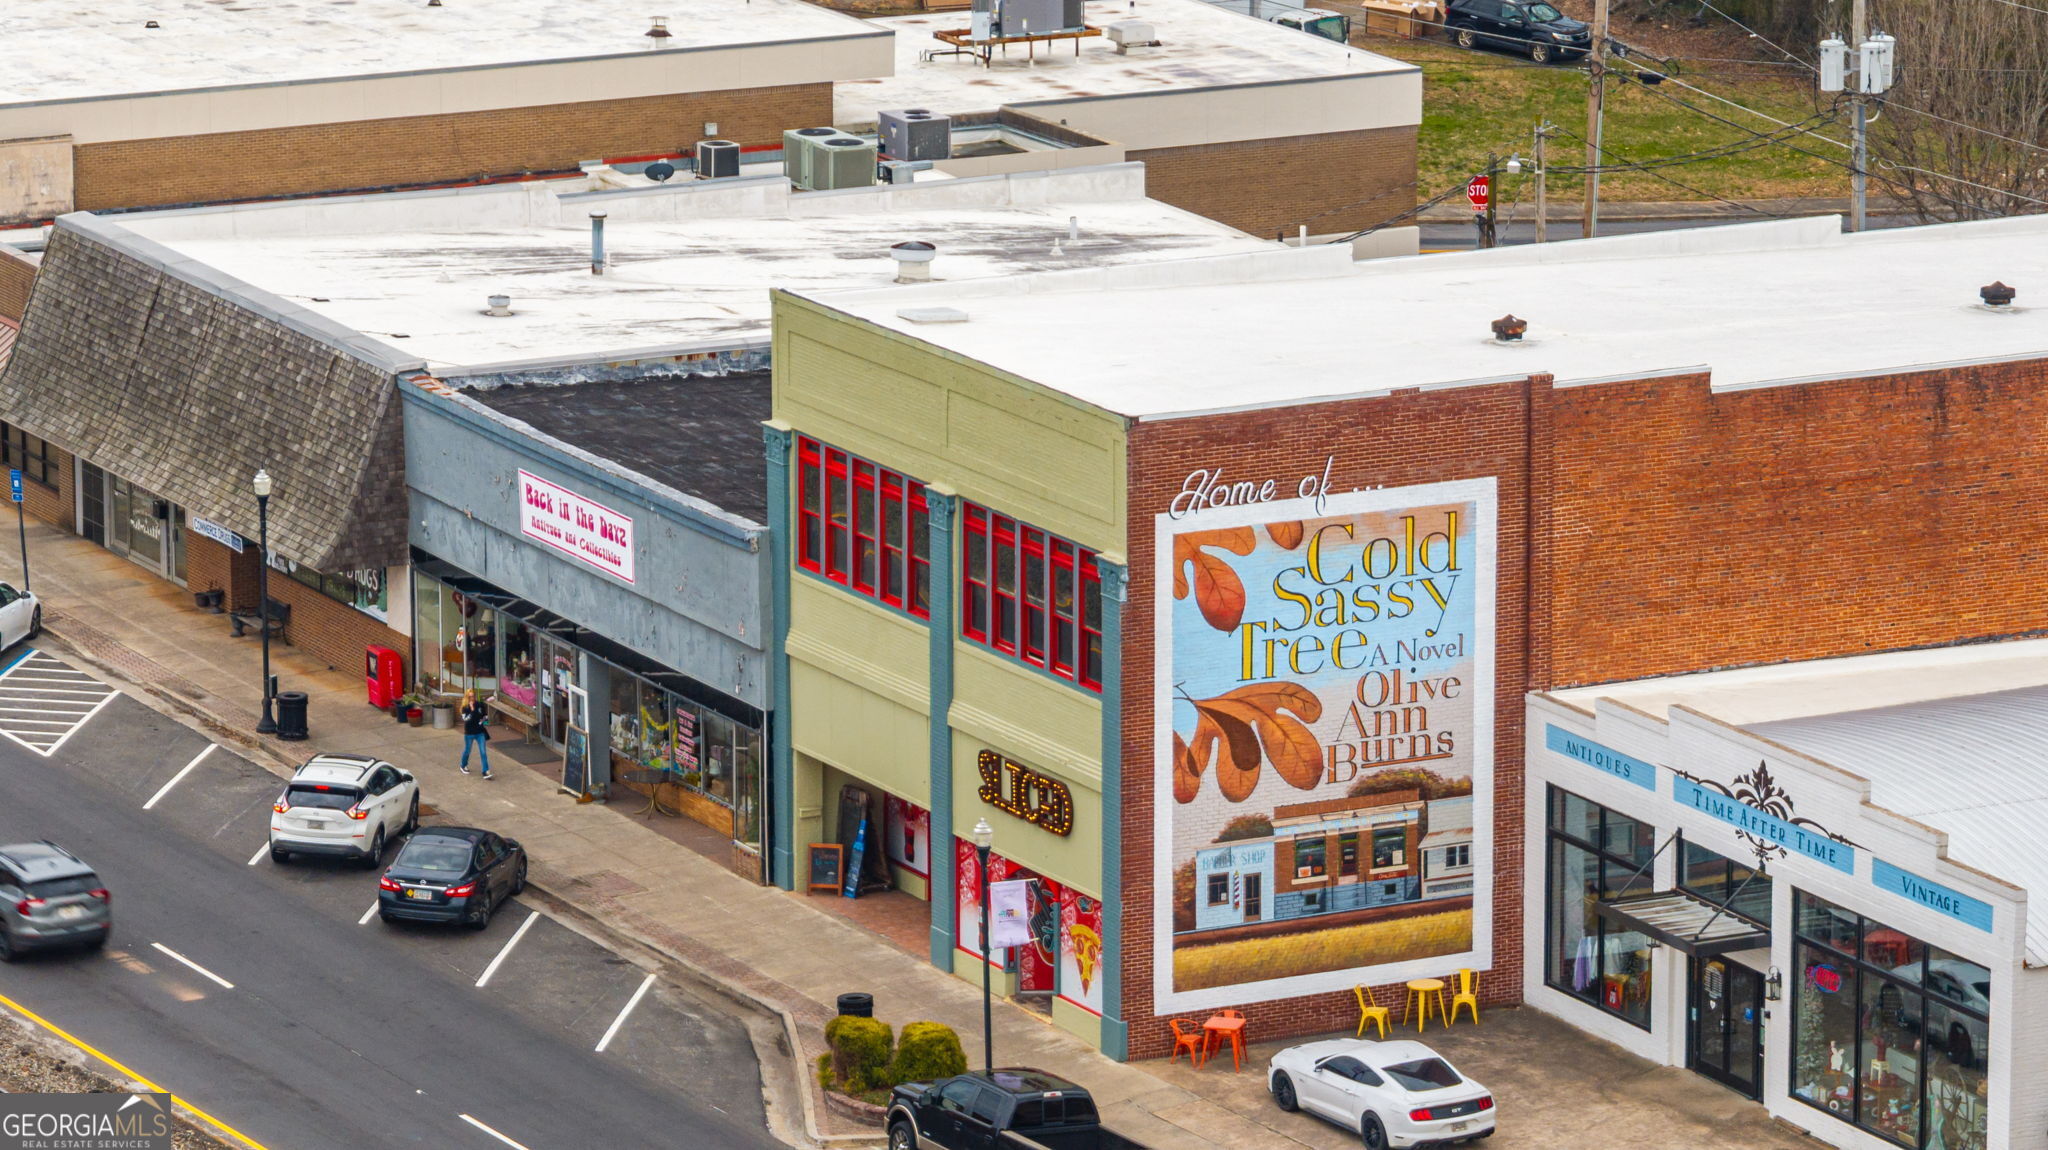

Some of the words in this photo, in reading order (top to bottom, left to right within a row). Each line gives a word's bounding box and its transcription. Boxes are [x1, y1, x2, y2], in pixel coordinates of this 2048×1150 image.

[1469, 185, 1487, 196] STO
[525, 482, 553, 514] Back
[559, 497, 570, 521] in
[576, 506, 594, 533] the
[1169, 467, 1276, 520] Home
[1298, 455, 1333, 516] of
[565, 532, 577, 546] and
[1306, 510, 1463, 586] Cold
[1272, 566, 1461, 638] Sassy
[1229, 621, 1369, 683] Tree
[1370, 643, 1389, 668] A
[1396, 633, 1465, 665] Novel
[1356, 667, 1461, 708] Olive
[1336, 700, 1429, 742] Ann
[1324, 729, 1455, 785] Burns
[1565, 740, 1631, 778] ANTIQUES
[1693, 788, 1734, 821] TIME
[1739, 808, 1786, 842] AFTER
[1796, 831, 1836, 864] TIME
[1902, 876, 1960, 915] VINTAGE
